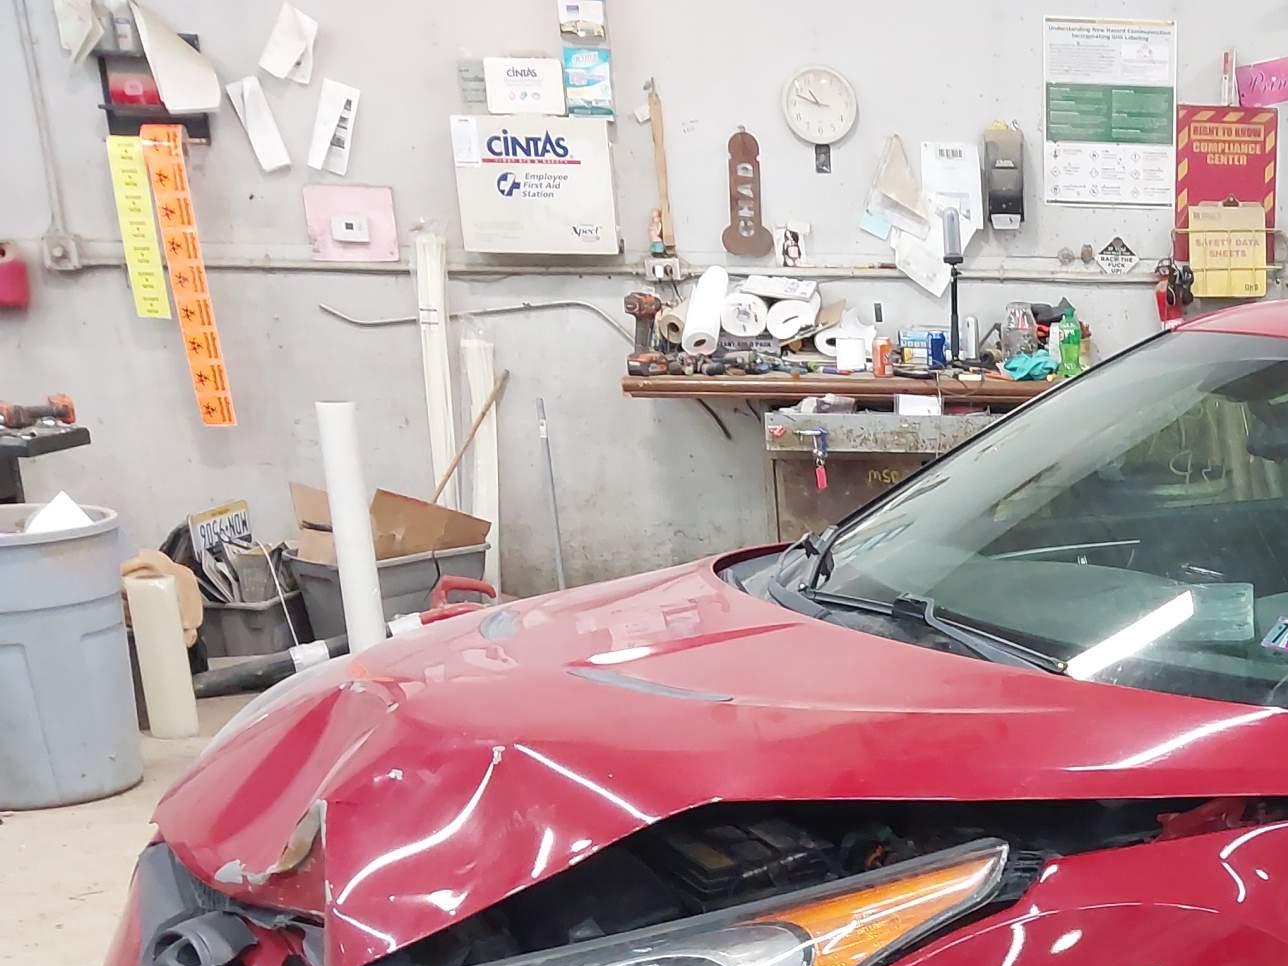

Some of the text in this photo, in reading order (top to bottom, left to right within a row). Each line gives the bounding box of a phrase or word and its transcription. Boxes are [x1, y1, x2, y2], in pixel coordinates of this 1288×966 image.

[1192, 126, 1262, 138] RIGHT TO KNOW
[486, 128, 569, 158] CINTAS
[1192, 141, 1262, 154] COMPLIANCE
[1206, 153, 1248, 165] CENTER
[524, 172, 569, 183] Employee
[522, 182, 561, 190] First Aid
[521, 190, 555, 199] Station
[1195, 239, 1260, 248] SAFETY DATA
